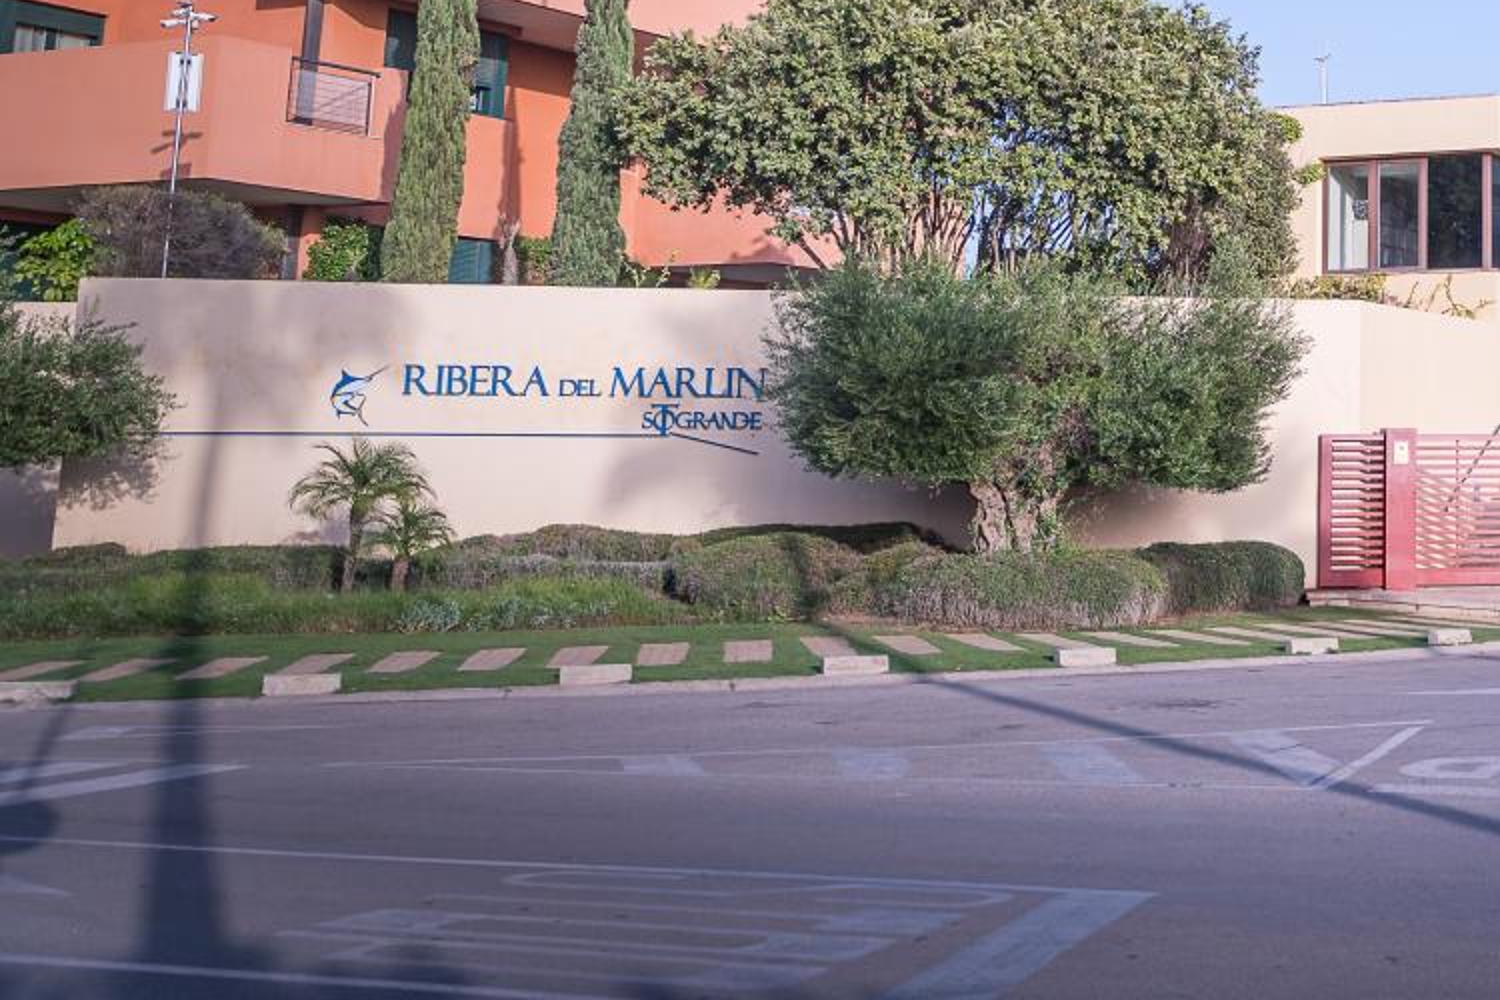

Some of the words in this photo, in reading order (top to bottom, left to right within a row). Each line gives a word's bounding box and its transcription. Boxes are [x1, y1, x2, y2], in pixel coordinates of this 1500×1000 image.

[402, 364, 549, 397] RIBERA
[559, 379, 602, 398] DEL
[609, 366, 769, 401] MARLIN
